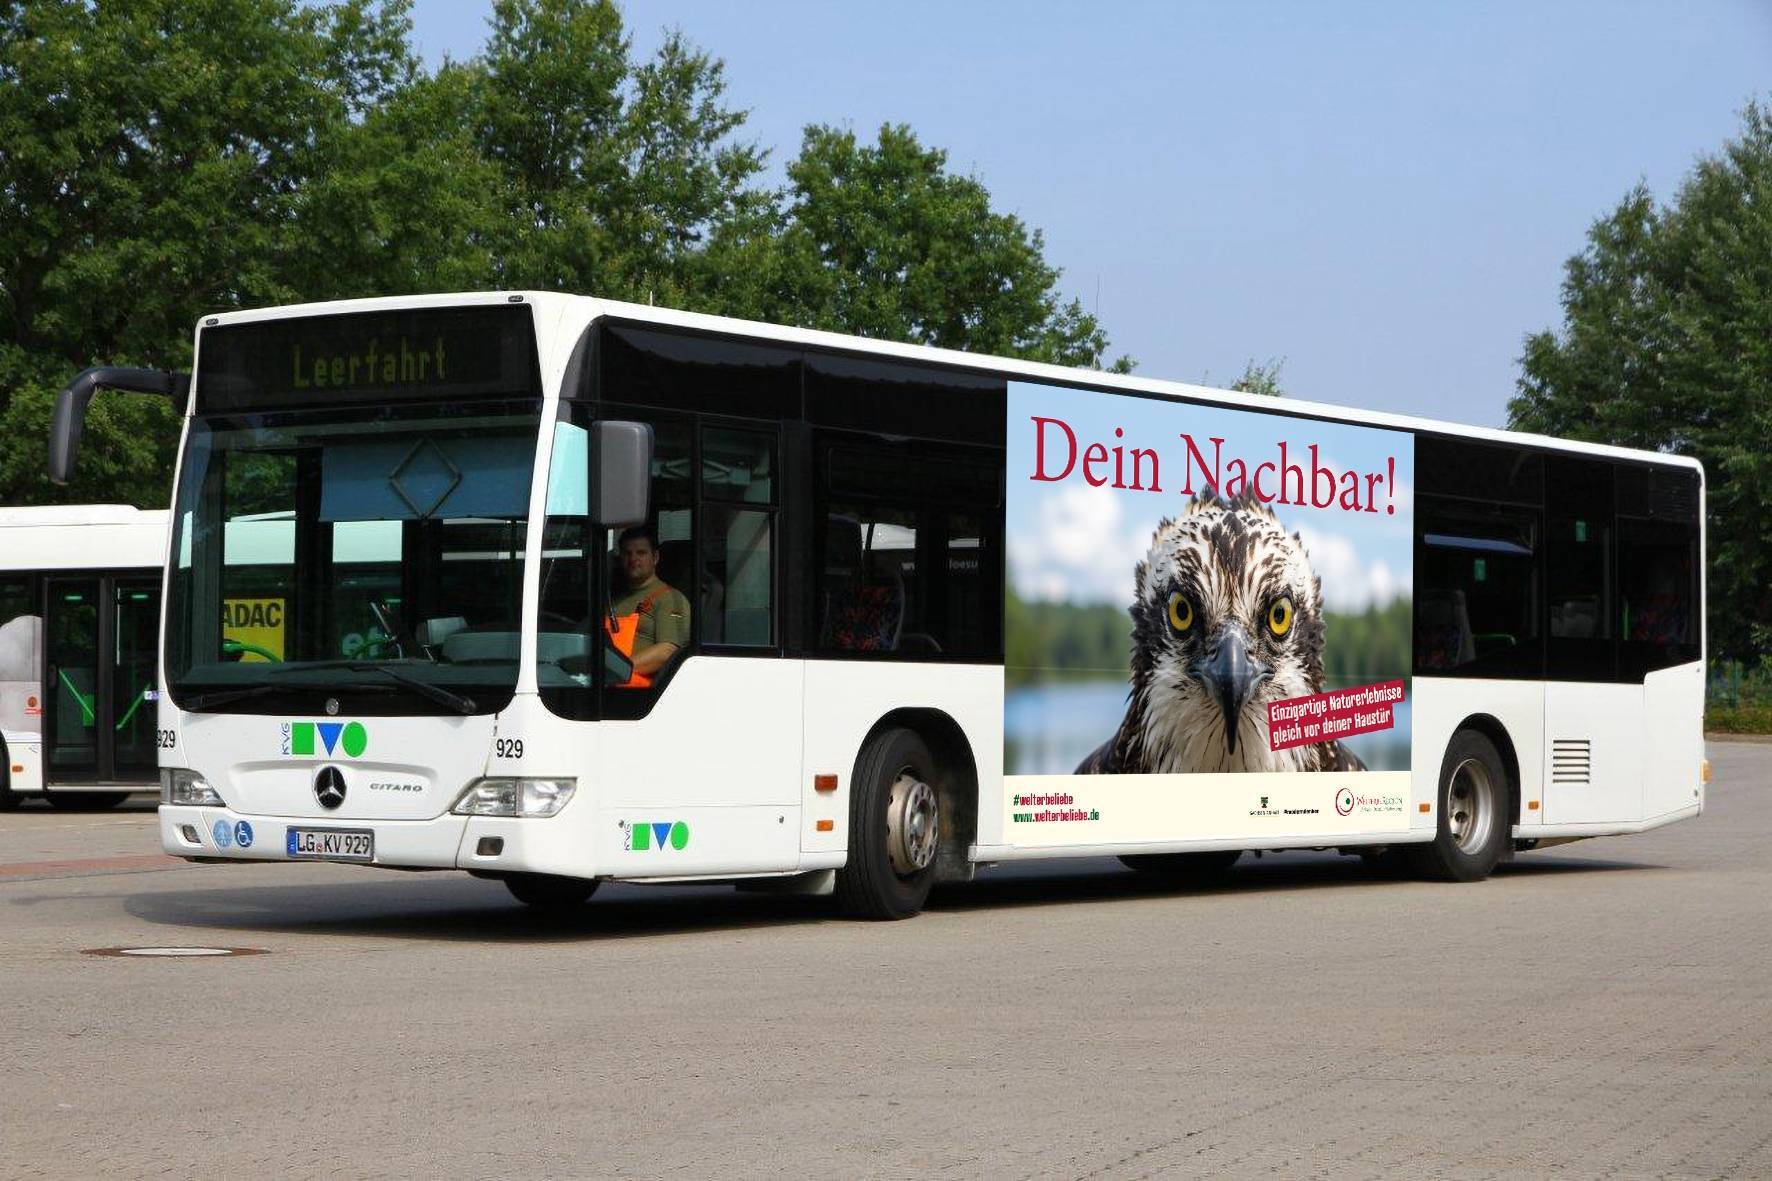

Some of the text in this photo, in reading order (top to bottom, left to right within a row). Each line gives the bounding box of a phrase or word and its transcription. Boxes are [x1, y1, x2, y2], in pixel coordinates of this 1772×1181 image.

[293, 337, 446, 388] Leerfahrt
[1030, 416, 1395, 515] Dein Nachbar!
[1271, 685, 1402, 722] Einzigartige Naturerlebnisse
[1273, 708, 1391, 748] gleich vor deiner Haustür
[496, 738, 523, 759] 929
[369, 783, 423, 791] CITARO
[1013, 792, 1074, 806] #welterbeliebe
[1013, 808, 1100, 823] www.welterbeliebe.de
[297, 833, 370, 855] LG KV 929
